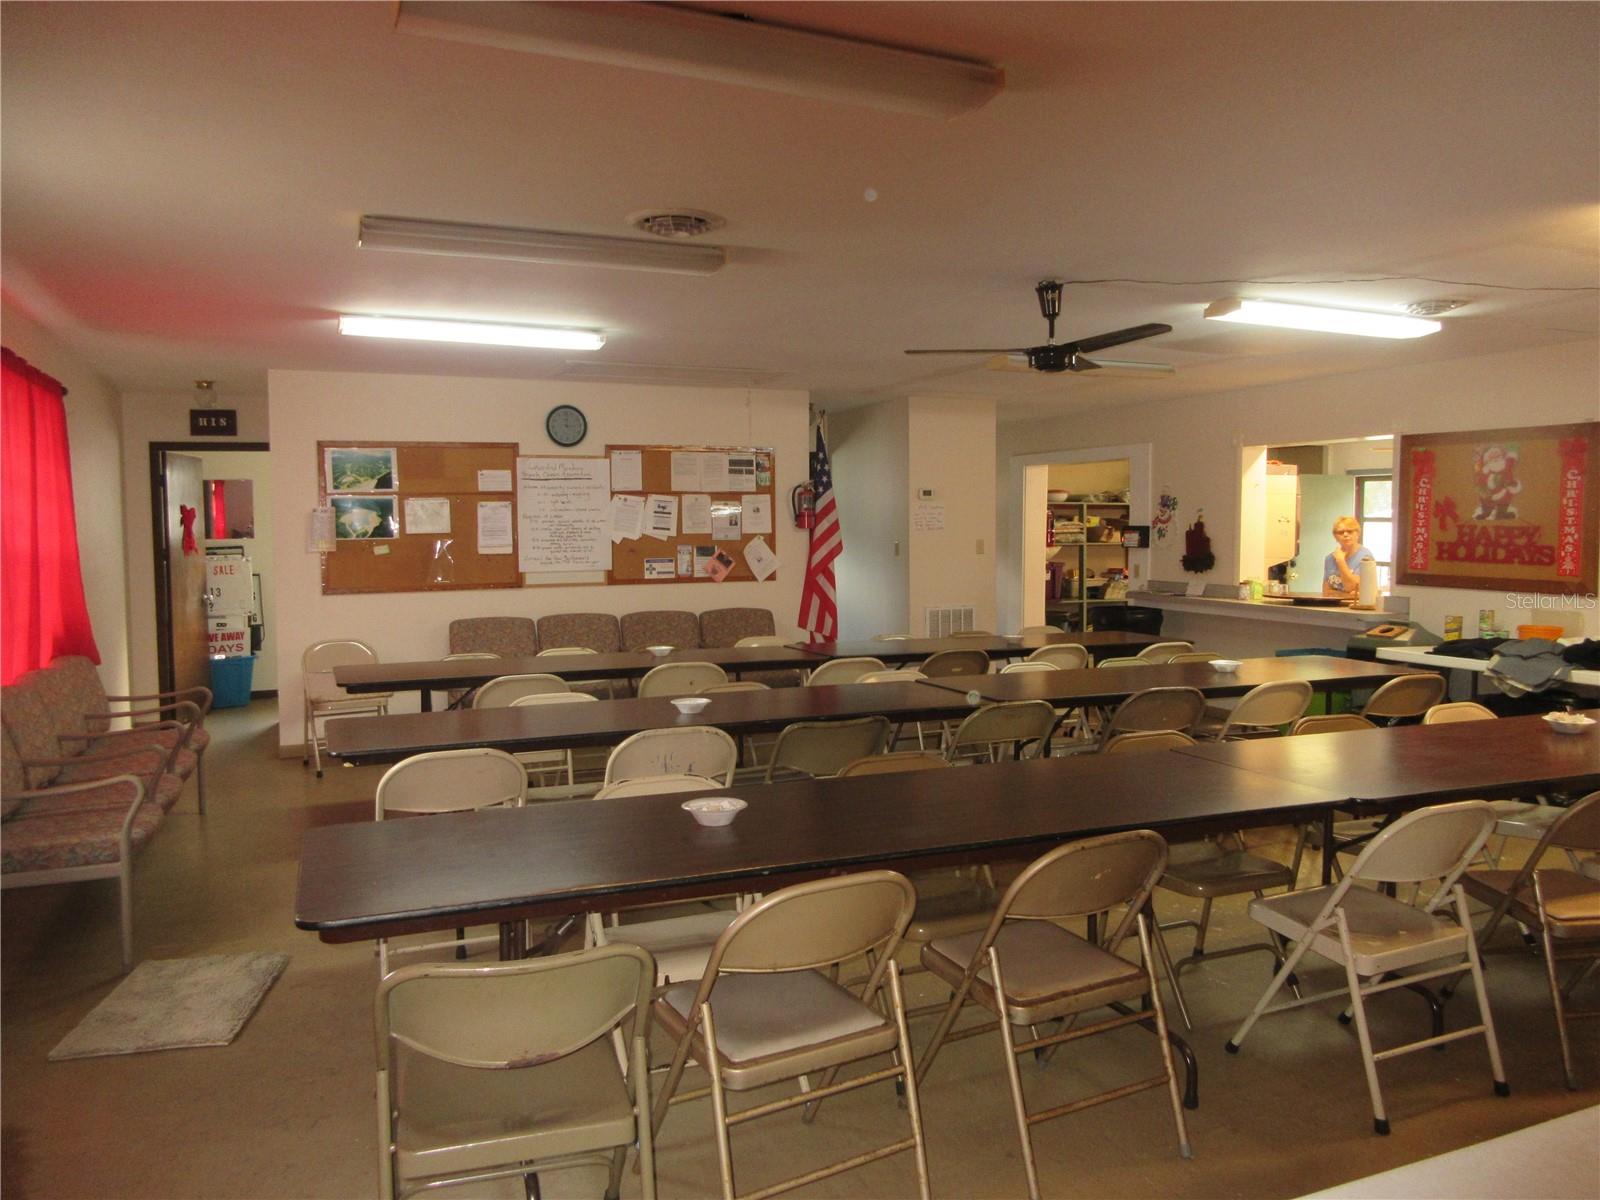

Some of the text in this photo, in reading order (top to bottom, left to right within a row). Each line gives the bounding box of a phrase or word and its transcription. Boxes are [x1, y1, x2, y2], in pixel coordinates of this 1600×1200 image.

[199, 417, 227, 427] HIS
[1415, 478, 1430, 550] CHRISTMAS
[1564, 469, 1580, 552] CHRISTMAS
[1456, 524, 1541, 546] HAPPY
[1436, 541, 1556, 567] HOLIDAYS
[213, 564, 235, 576] SALE
[221, 631, 245, 641] AWAY
[209, 643, 245, 655] DAYS
